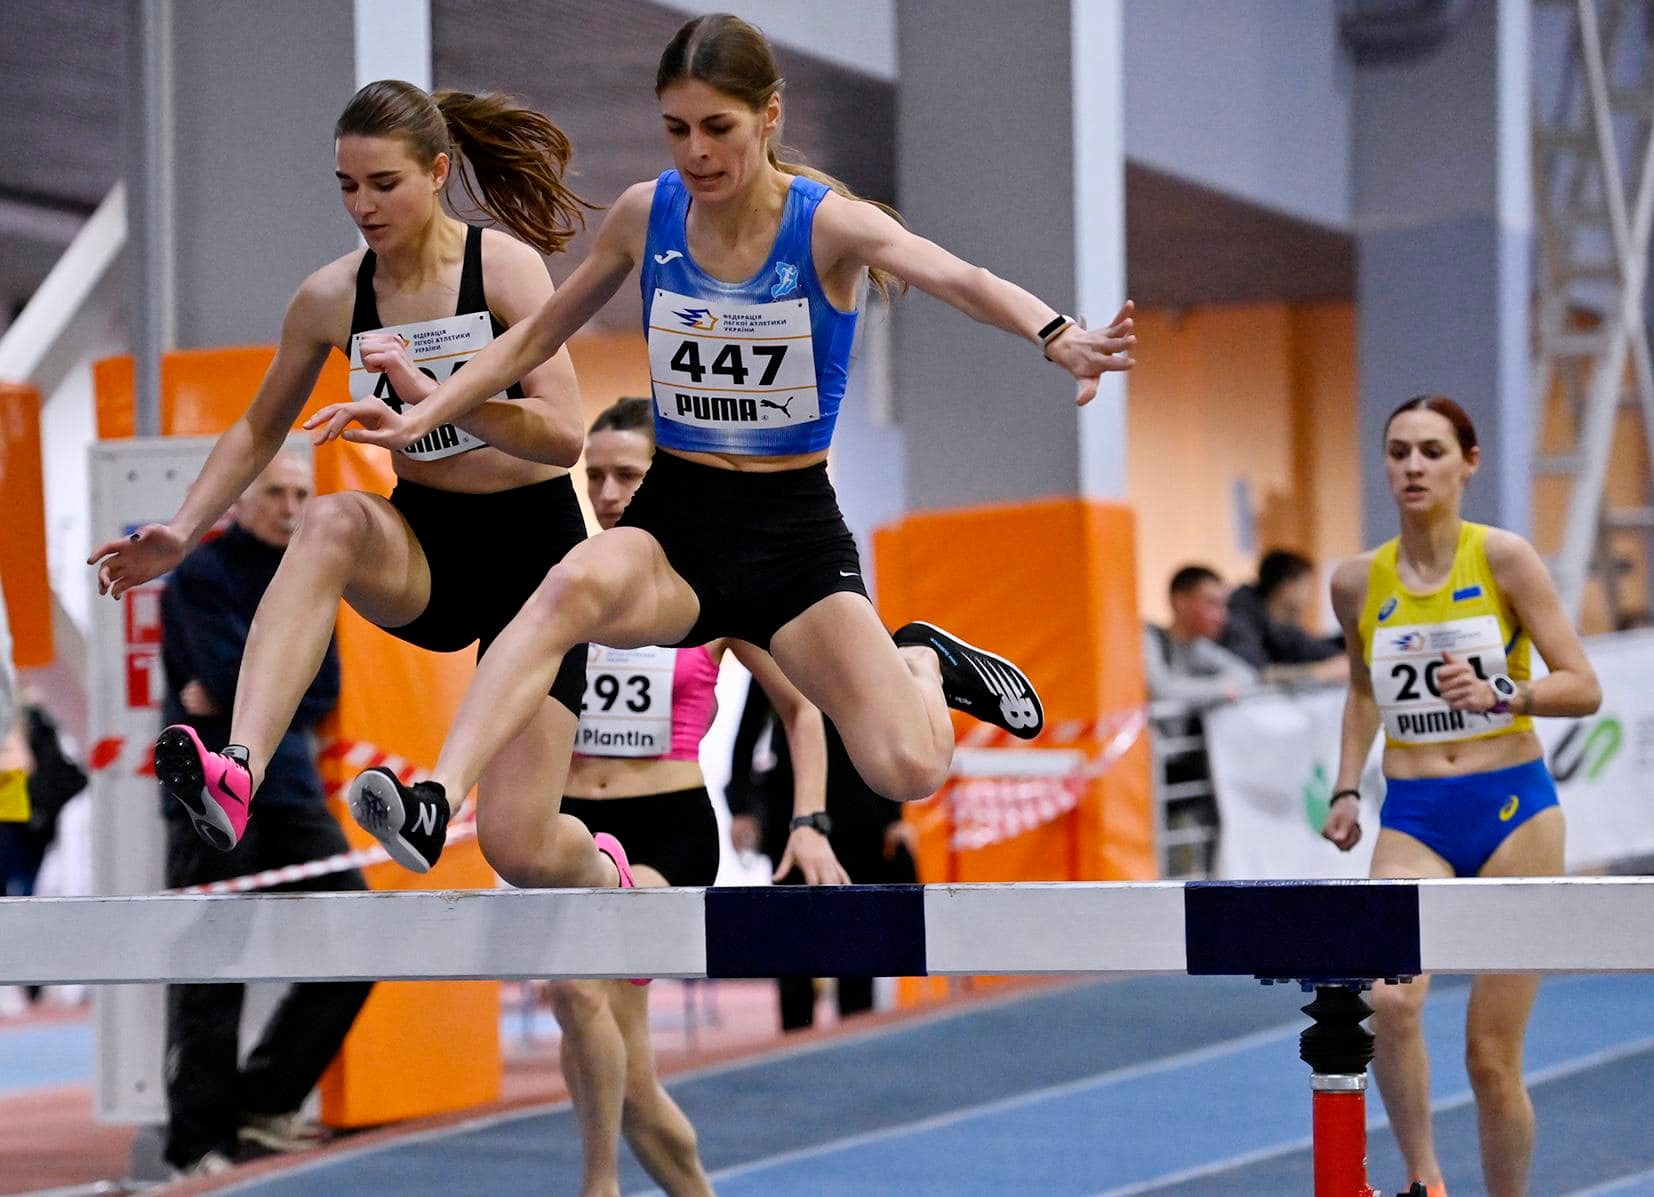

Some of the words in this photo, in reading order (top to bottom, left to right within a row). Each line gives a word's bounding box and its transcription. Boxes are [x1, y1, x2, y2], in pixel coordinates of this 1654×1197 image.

[670, 340, 788, 386] 447
[675, 393, 758, 421] PUMA
[581, 674, 651, 713] 93
[1397, 710, 1465, 735] PUMA
